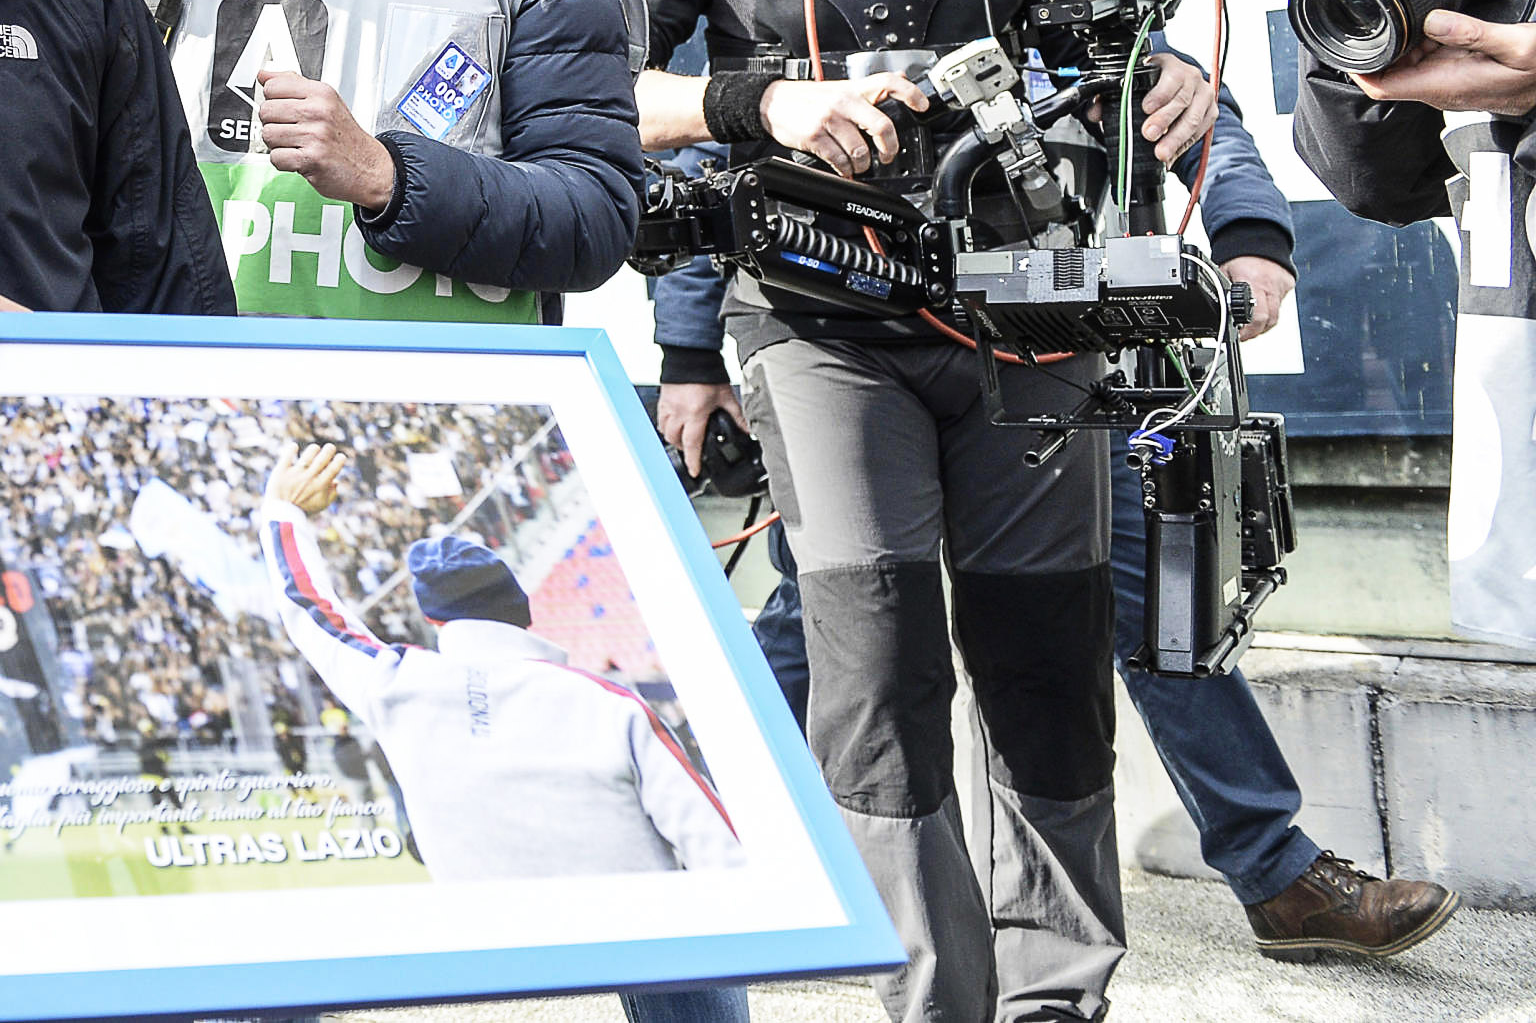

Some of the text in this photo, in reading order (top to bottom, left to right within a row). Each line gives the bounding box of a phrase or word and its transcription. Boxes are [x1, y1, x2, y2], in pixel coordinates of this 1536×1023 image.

[416, 84, 453, 119] PHOTO
[219, 118, 263, 141] SER
[846, 202, 893, 224] STEADICAM
[174, 769, 240, 803] spirito
[97, 800, 203, 835] importante
[207, 804, 264, 823] siamo
[144, 827, 403, 868] ULTRAS LAZIO
